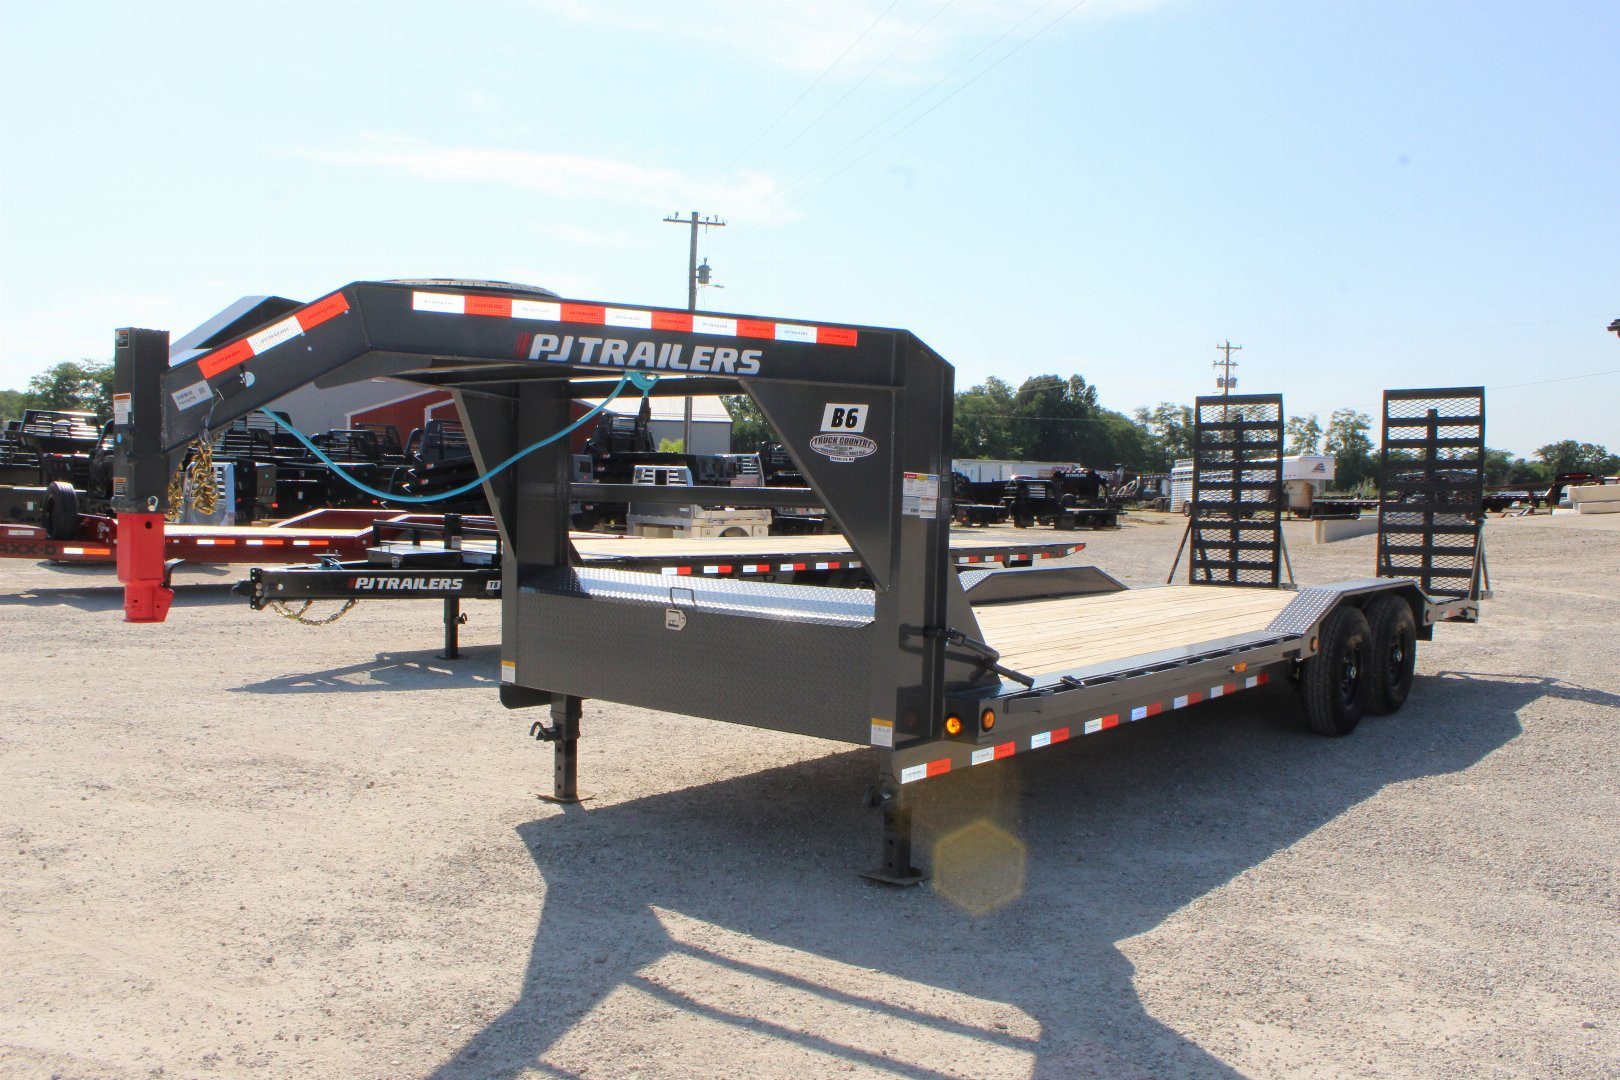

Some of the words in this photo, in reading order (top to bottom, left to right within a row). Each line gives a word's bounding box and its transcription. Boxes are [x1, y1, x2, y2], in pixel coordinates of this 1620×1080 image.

[578, 336, 763, 375] TRAILERS
[831, 407, 859, 428] B6
[814, 436, 838, 445] TRUCK
[839, 436, 872, 448] COUNTRY
[376, 577, 464, 590] TRAILERS
